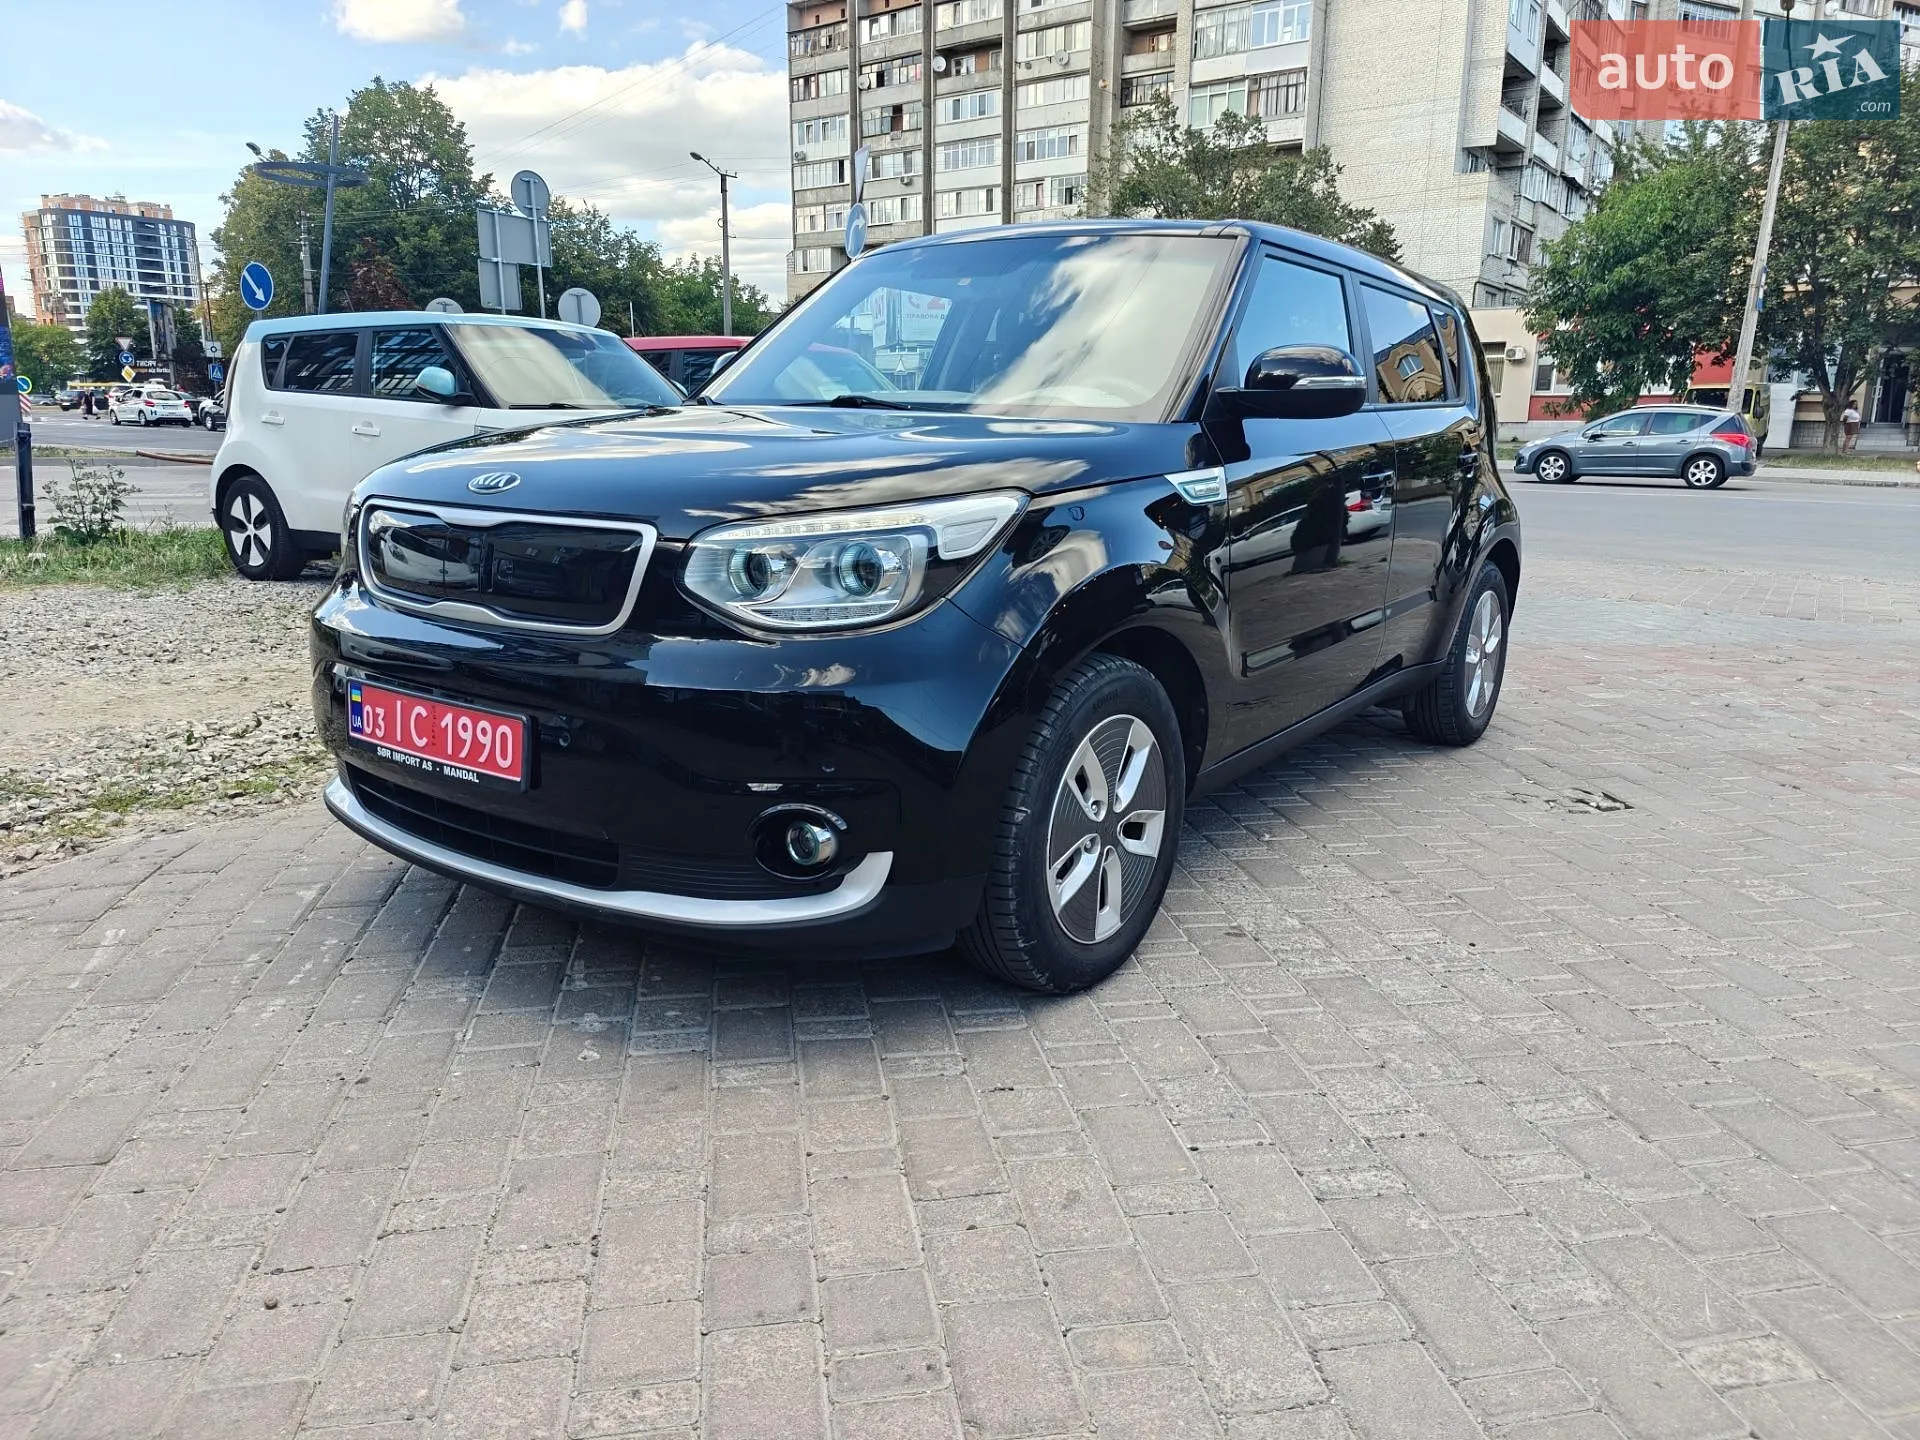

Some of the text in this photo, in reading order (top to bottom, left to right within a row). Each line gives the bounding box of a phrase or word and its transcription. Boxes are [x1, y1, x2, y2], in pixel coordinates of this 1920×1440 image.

[471, 473, 512, 488] KIA
[352, 714, 362, 728] UA
[363, 704, 385, 738] 03
[395, 700, 429, 748] IC
[440, 712, 514, 769] 1990
[376, 746, 392, 760] SØR
[392, 749, 420, 768] IMPORT
[421, 760, 433, 771] AS
[443, 764, 480, 783] MANDAL
